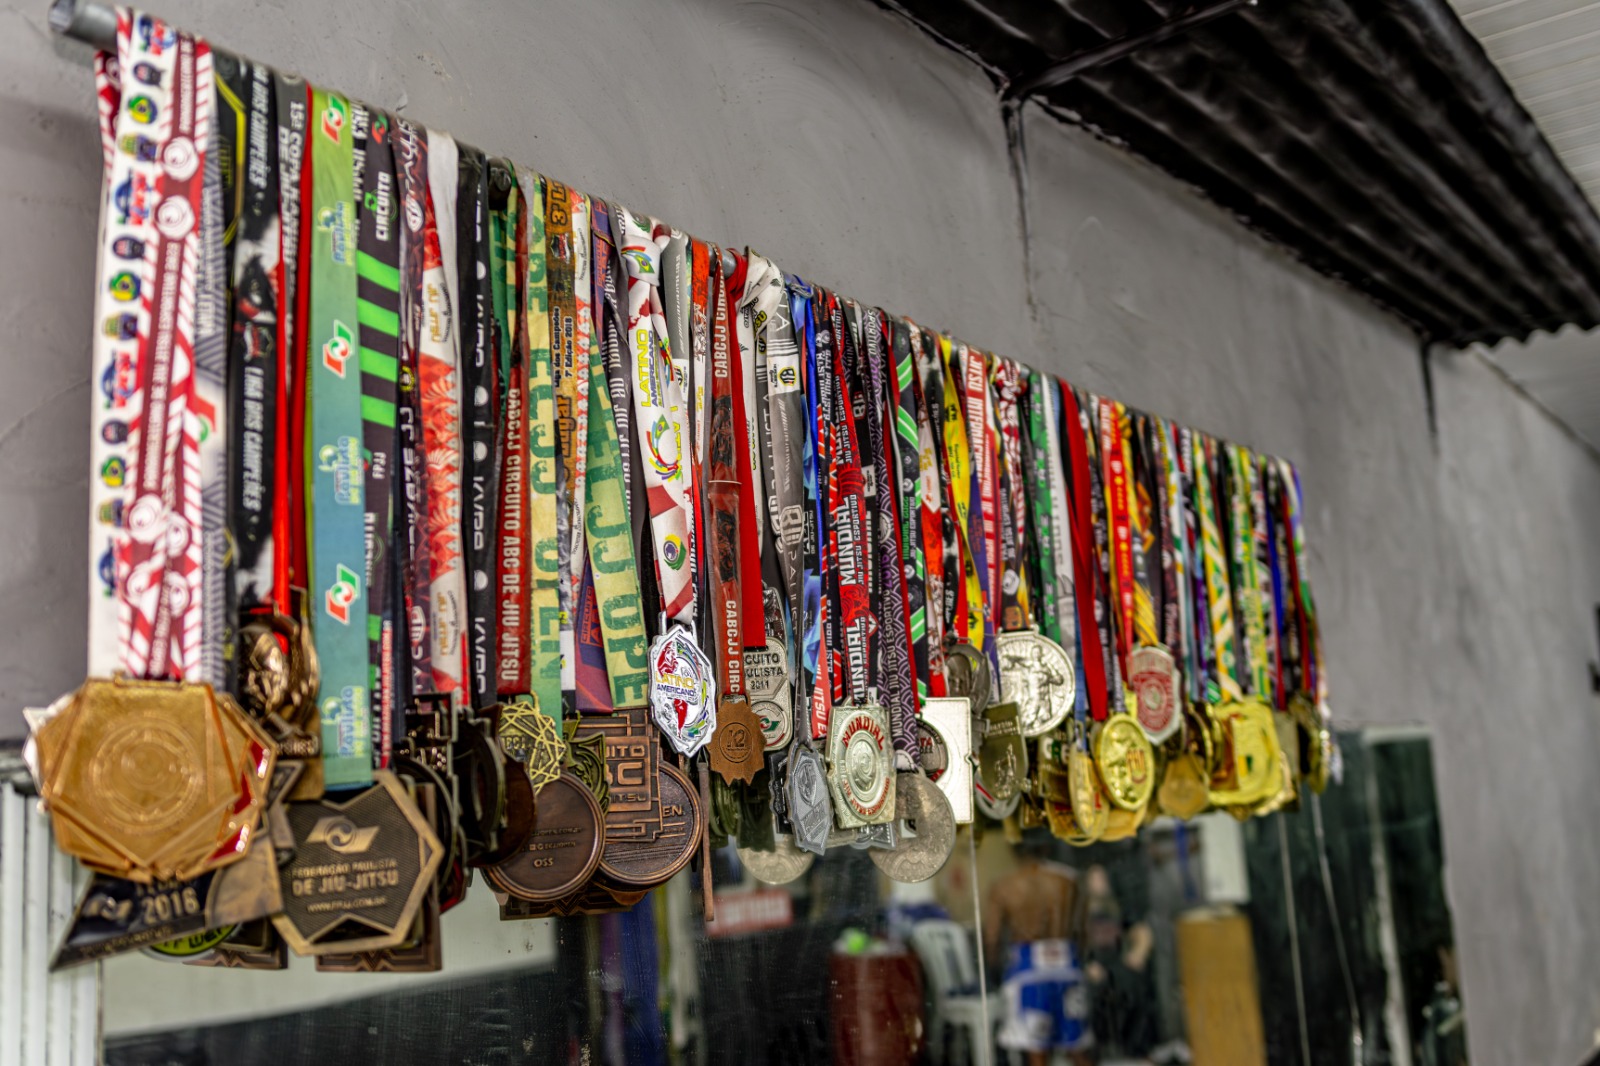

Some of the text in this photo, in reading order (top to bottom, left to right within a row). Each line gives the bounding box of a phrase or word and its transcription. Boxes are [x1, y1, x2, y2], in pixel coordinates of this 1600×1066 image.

[289, 132, 302, 181] COPA
[376, 173, 390, 242] CIRCUITO
[867, 309, 877, 356] SPORTIVO
[636, 330, 651, 409] LATINO
[648, 330, 658, 407] AMERICANO
[714, 325, 728, 379] CABCJJ
[968, 354, 982, 391] JITSU
[842, 427, 851, 450] JITSU
[372, 452, 385, 479] FPJJ
[845, 451, 853, 466] JIU
[504, 455, 521, 530] CIRCUITO
[849, 496, 860, 543] ESPORTIVO
[908, 496, 916, 531] ESPORTIVO
[503, 536, 520, 569] ABC
[837, 499, 857, 588] MUNDIAL
[854, 547, 863, 570] JITSU
[503, 573, 520, 592] DE
[502, 599, 520, 627] JIU
[581, 586, 593, 642] CIRCUITO
[881, 591, 895, 645] ESPORTIVO
[501, 632, 519, 681] JITSU
[602, 593, 650, 705] OPE
[725, 598, 740, 693] CABCJJ CIRC
[744, 652, 780, 665] CUITO
[885, 648, 897, 674] JITSU
[655, 671, 695, 690] LATINO
[746, 667, 784, 677] ULISTA
[750, 679, 769, 690] 2011
[888, 675, 899, 690] JIU
[656, 684, 696, 697] AMERICANO
[842, 715, 884, 750] MUNDIAL
[889, 693, 903, 739] MUNDIAL
[607, 761, 643, 785] BC
[533, 857, 554, 868] OSS
[292, 868, 399, 896] DE JIU-JITSU
[140, 887, 200, 924] 2016
